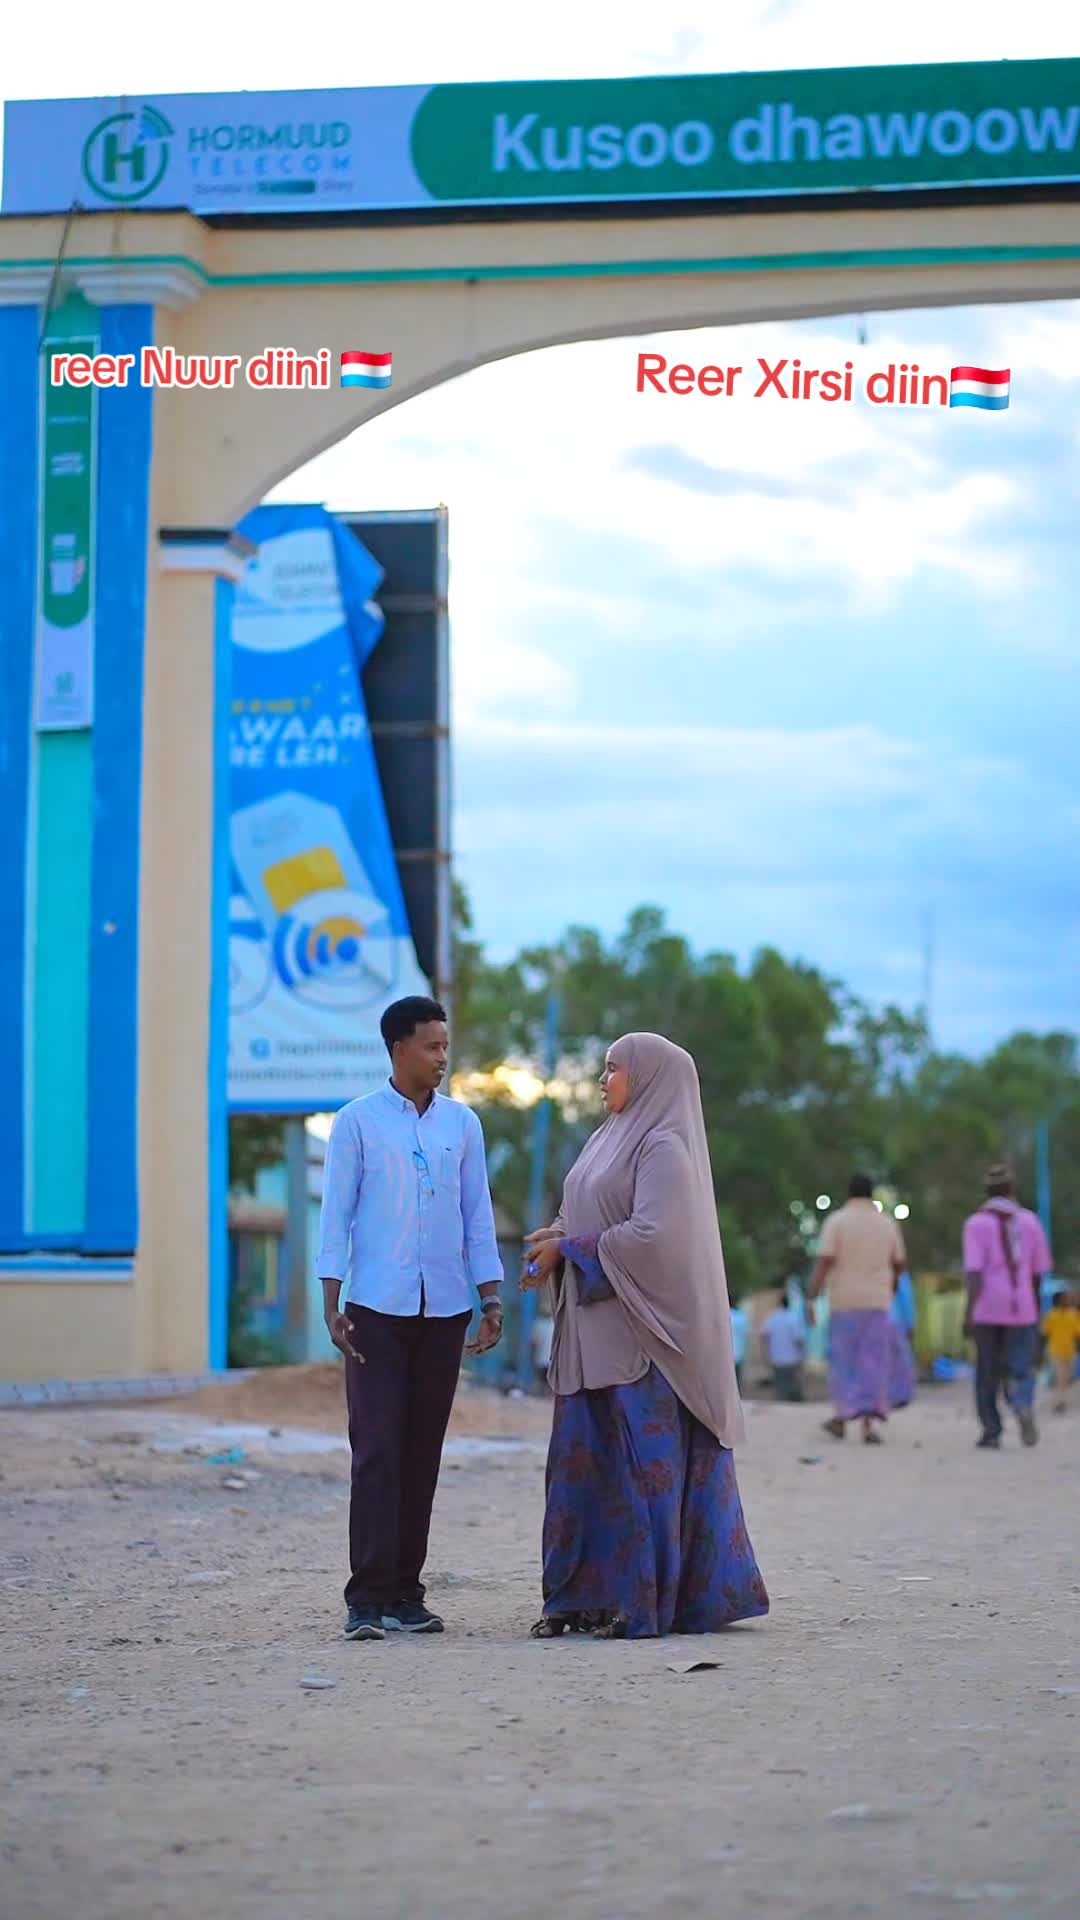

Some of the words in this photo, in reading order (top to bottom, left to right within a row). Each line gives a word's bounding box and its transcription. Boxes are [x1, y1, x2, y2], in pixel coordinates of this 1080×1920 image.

[188, 120, 353, 152] HORMUUD
[492, 112, 714, 172] Kusoo
[729, 103, 1080, 164] dhawoow
[189, 153, 353, 177] TELECOM
[230, 713, 369, 743] WAAR
